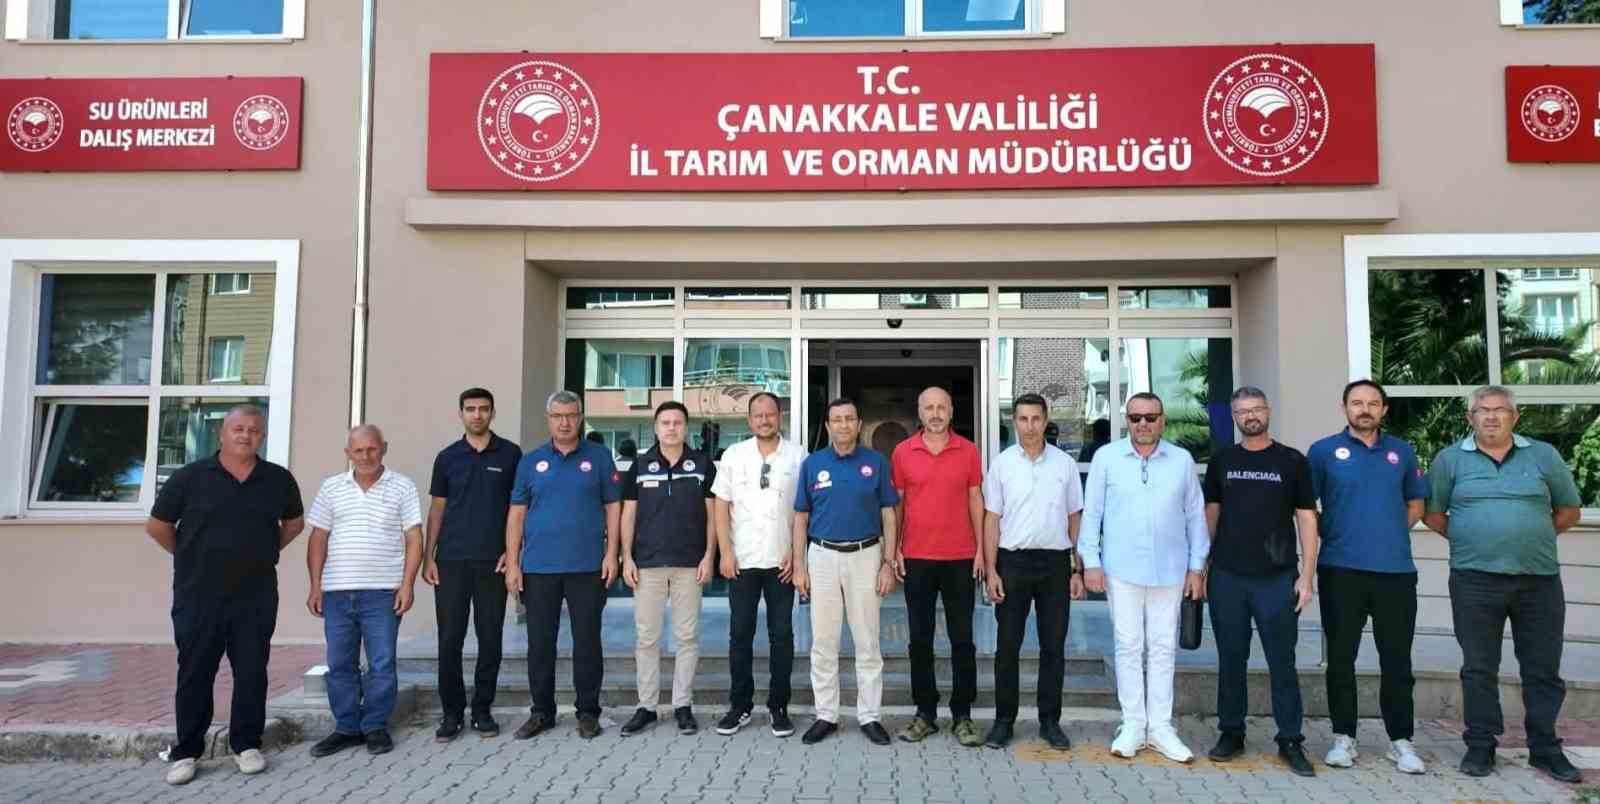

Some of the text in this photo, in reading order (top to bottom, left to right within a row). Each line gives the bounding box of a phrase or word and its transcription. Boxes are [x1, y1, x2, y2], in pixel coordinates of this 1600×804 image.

[857, 66, 920, 95] T.C.
[89, 97, 208, 121] SU ÜRÜNLERİ
[717, 92, 1098, 142] ÇANAKKALE VALİLİĞİ
[79, 124, 215, 151] DALIŞ MERKEZİ
[630, 137, 1192, 176] İL TARIM VE ORMAN MÜDÜRLÜĞÜ
[1226, 471, 1282, 482] BALENCIAGA
